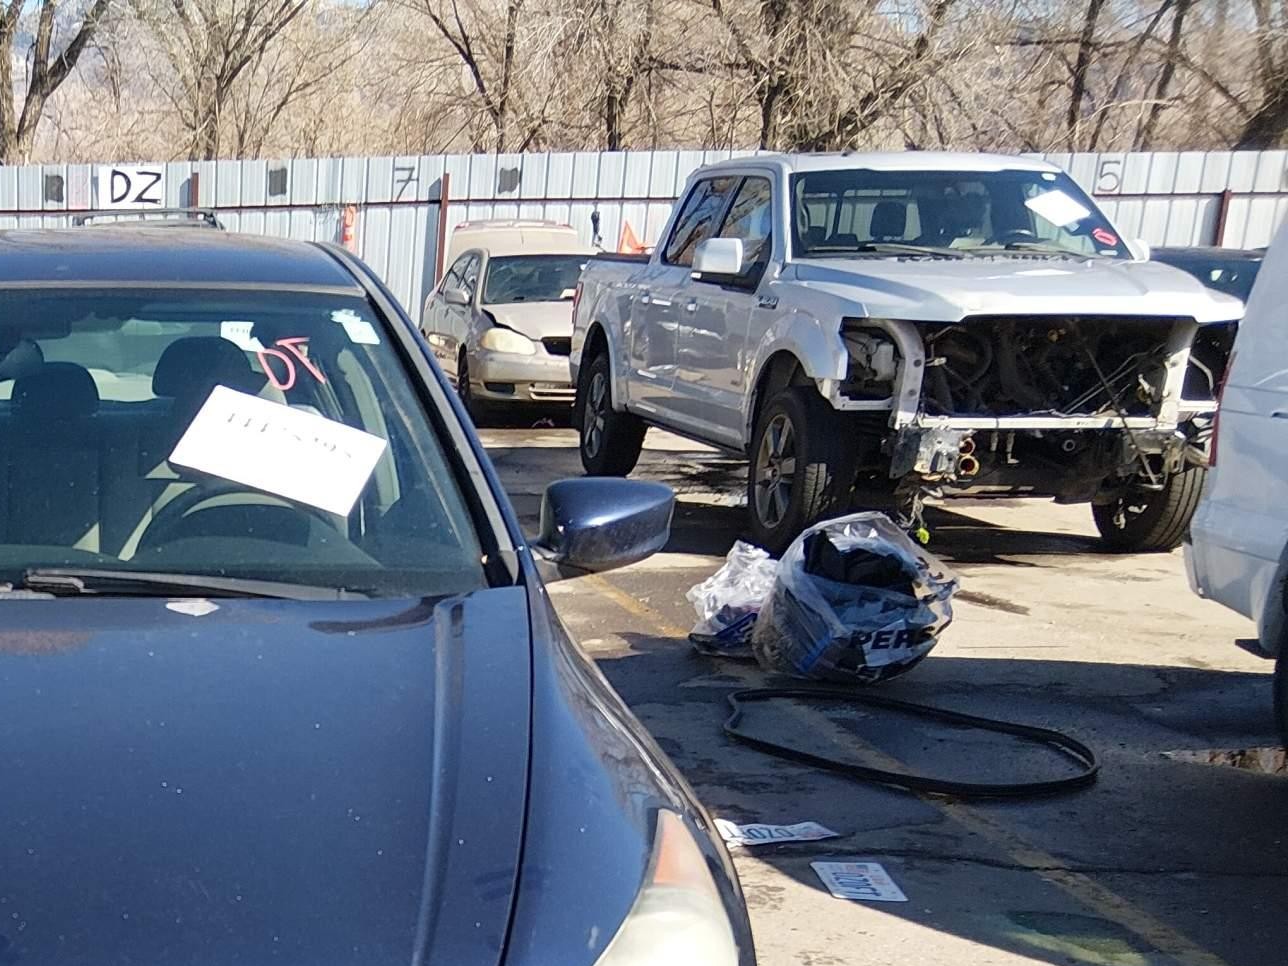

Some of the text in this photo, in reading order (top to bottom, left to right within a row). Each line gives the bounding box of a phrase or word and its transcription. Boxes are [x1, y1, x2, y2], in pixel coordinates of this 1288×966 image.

[110, 169, 162, 204] DZ
[395, 166, 419, 202] 7
[1098, 160, 1121, 192] 5
